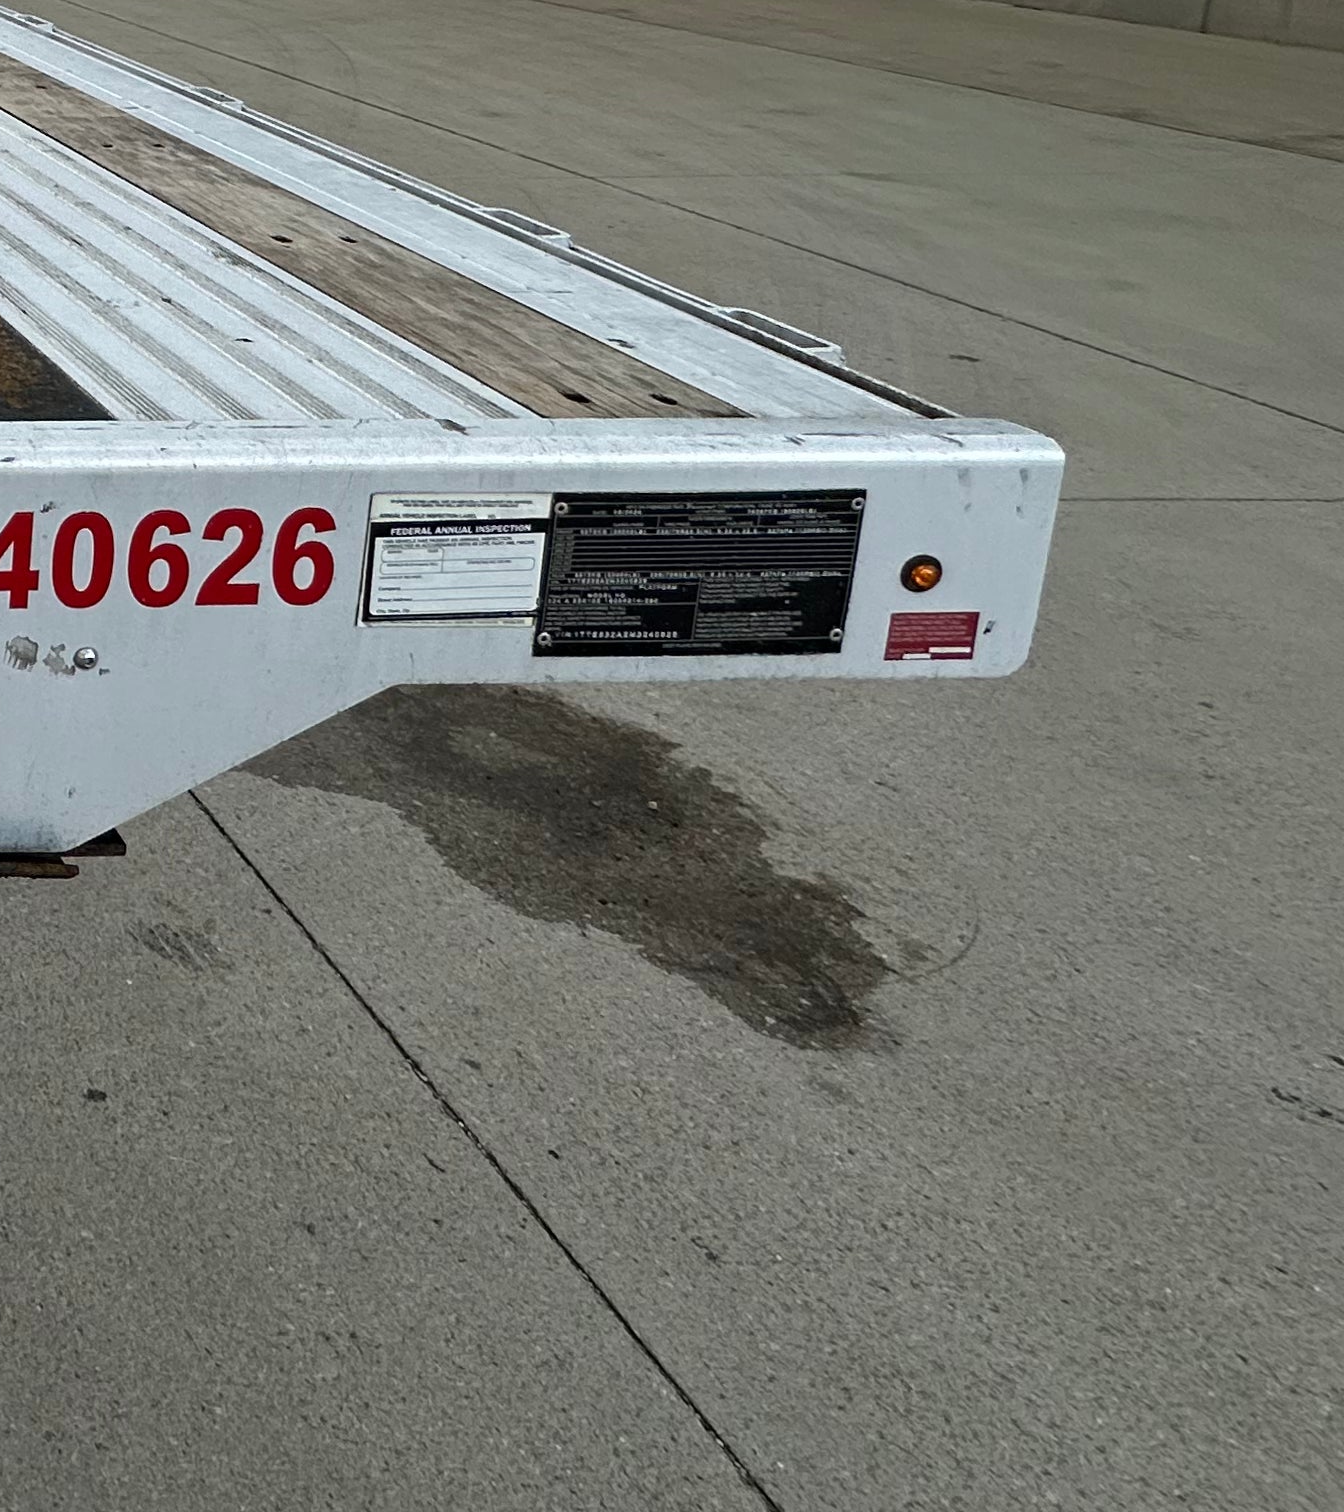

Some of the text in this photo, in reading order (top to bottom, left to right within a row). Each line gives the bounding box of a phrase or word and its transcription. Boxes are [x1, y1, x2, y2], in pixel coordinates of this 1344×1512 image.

[390, 524, 531, 536] FEDERAL ANNUAL INSPECTION
